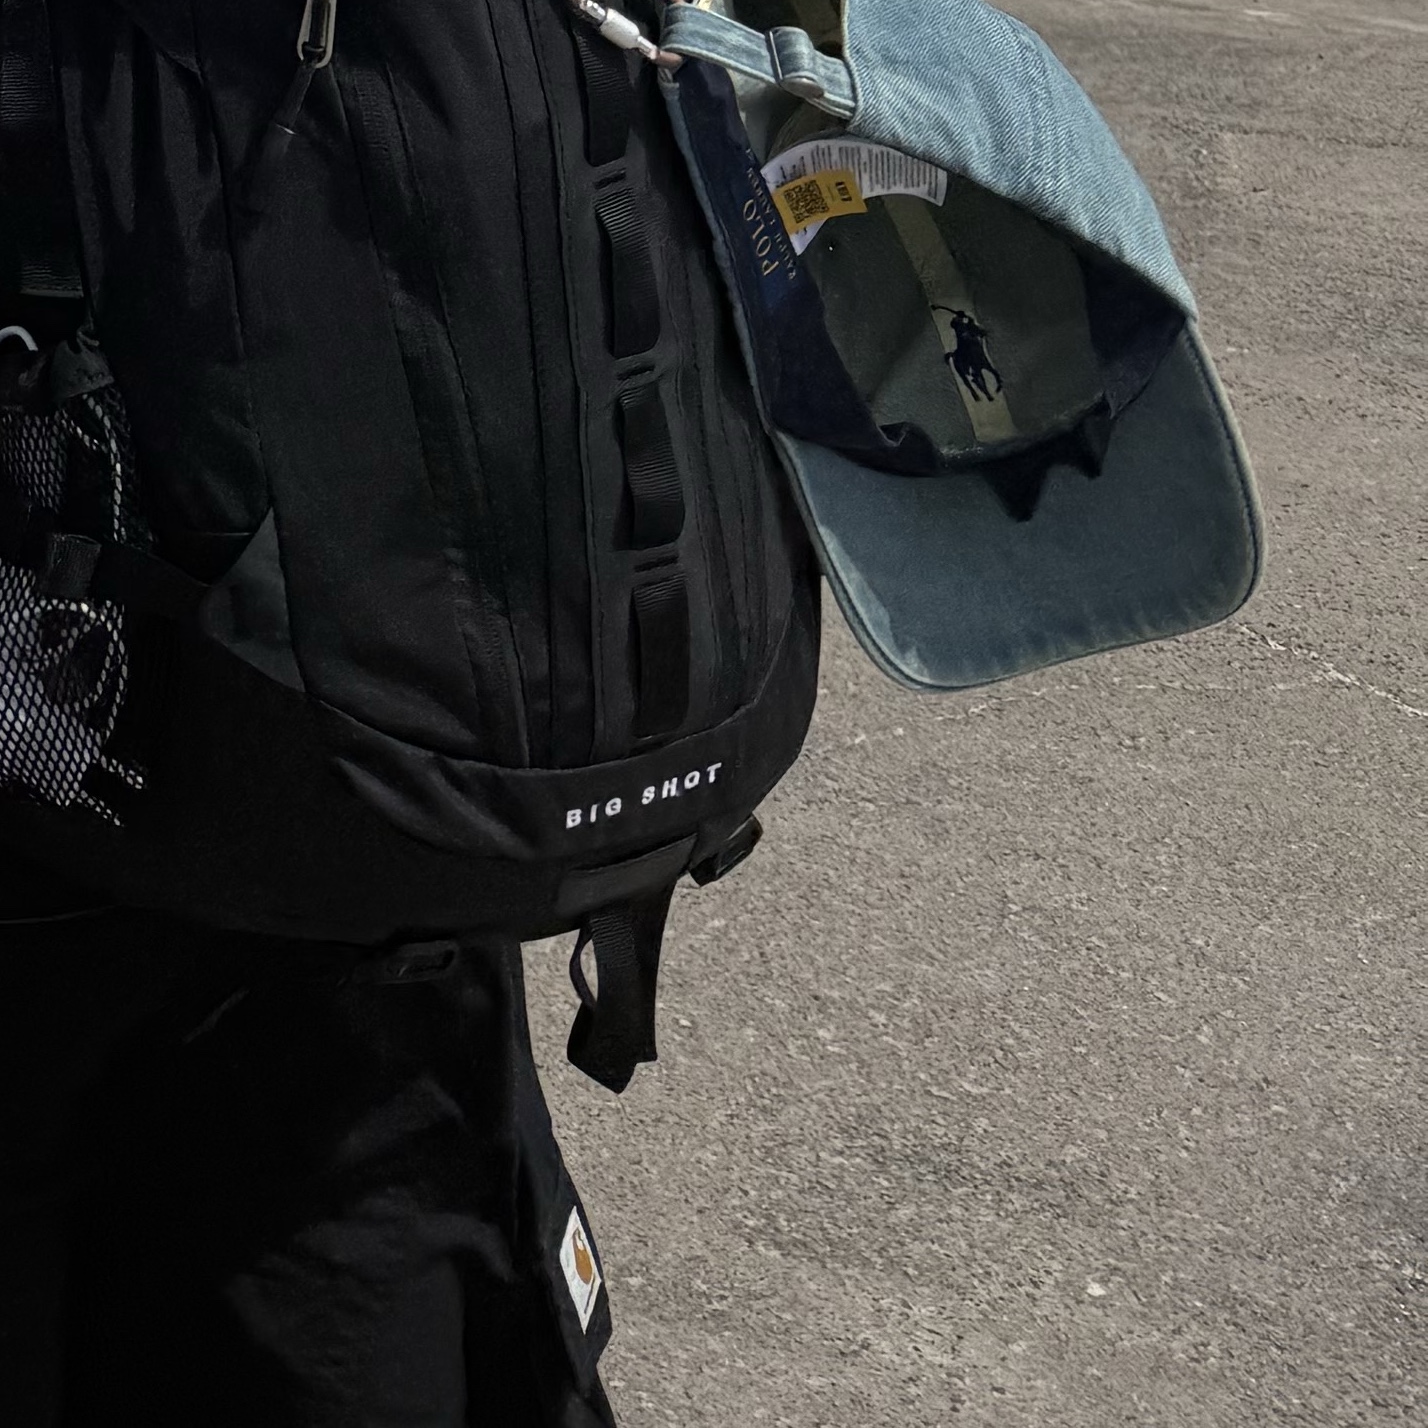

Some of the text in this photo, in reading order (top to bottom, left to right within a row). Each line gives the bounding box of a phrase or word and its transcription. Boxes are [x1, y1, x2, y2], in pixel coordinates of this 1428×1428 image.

[743, 199, 780, 276] POLO
[565, 762, 723, 829] BIG SHOT
